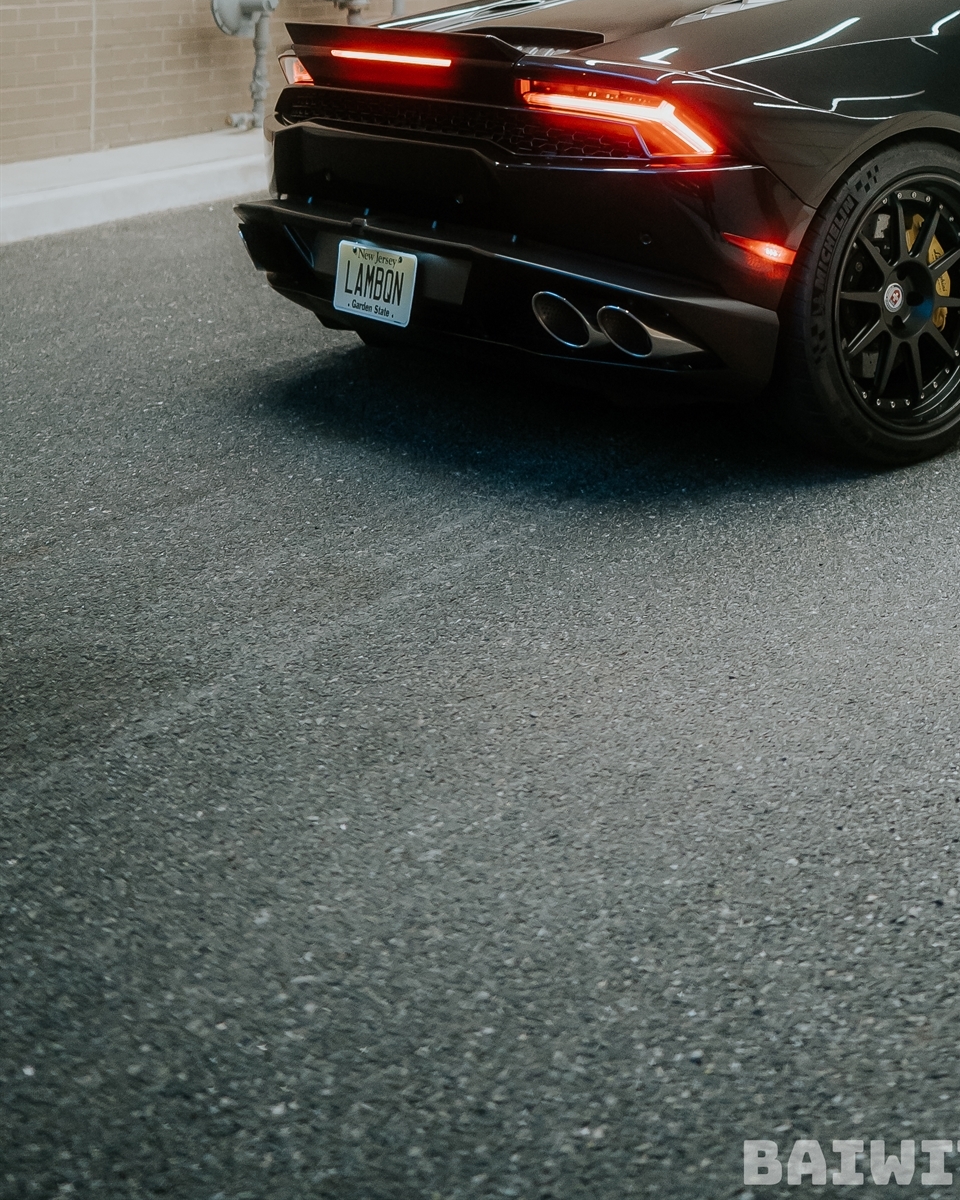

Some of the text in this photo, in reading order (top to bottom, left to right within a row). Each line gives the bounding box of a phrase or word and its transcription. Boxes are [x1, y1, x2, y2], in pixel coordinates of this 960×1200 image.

[814, 195, 855, 290] MICHELIN
[358, 248, 397, 267] New Jersey
[351, 299, 390, 317] Garden State
